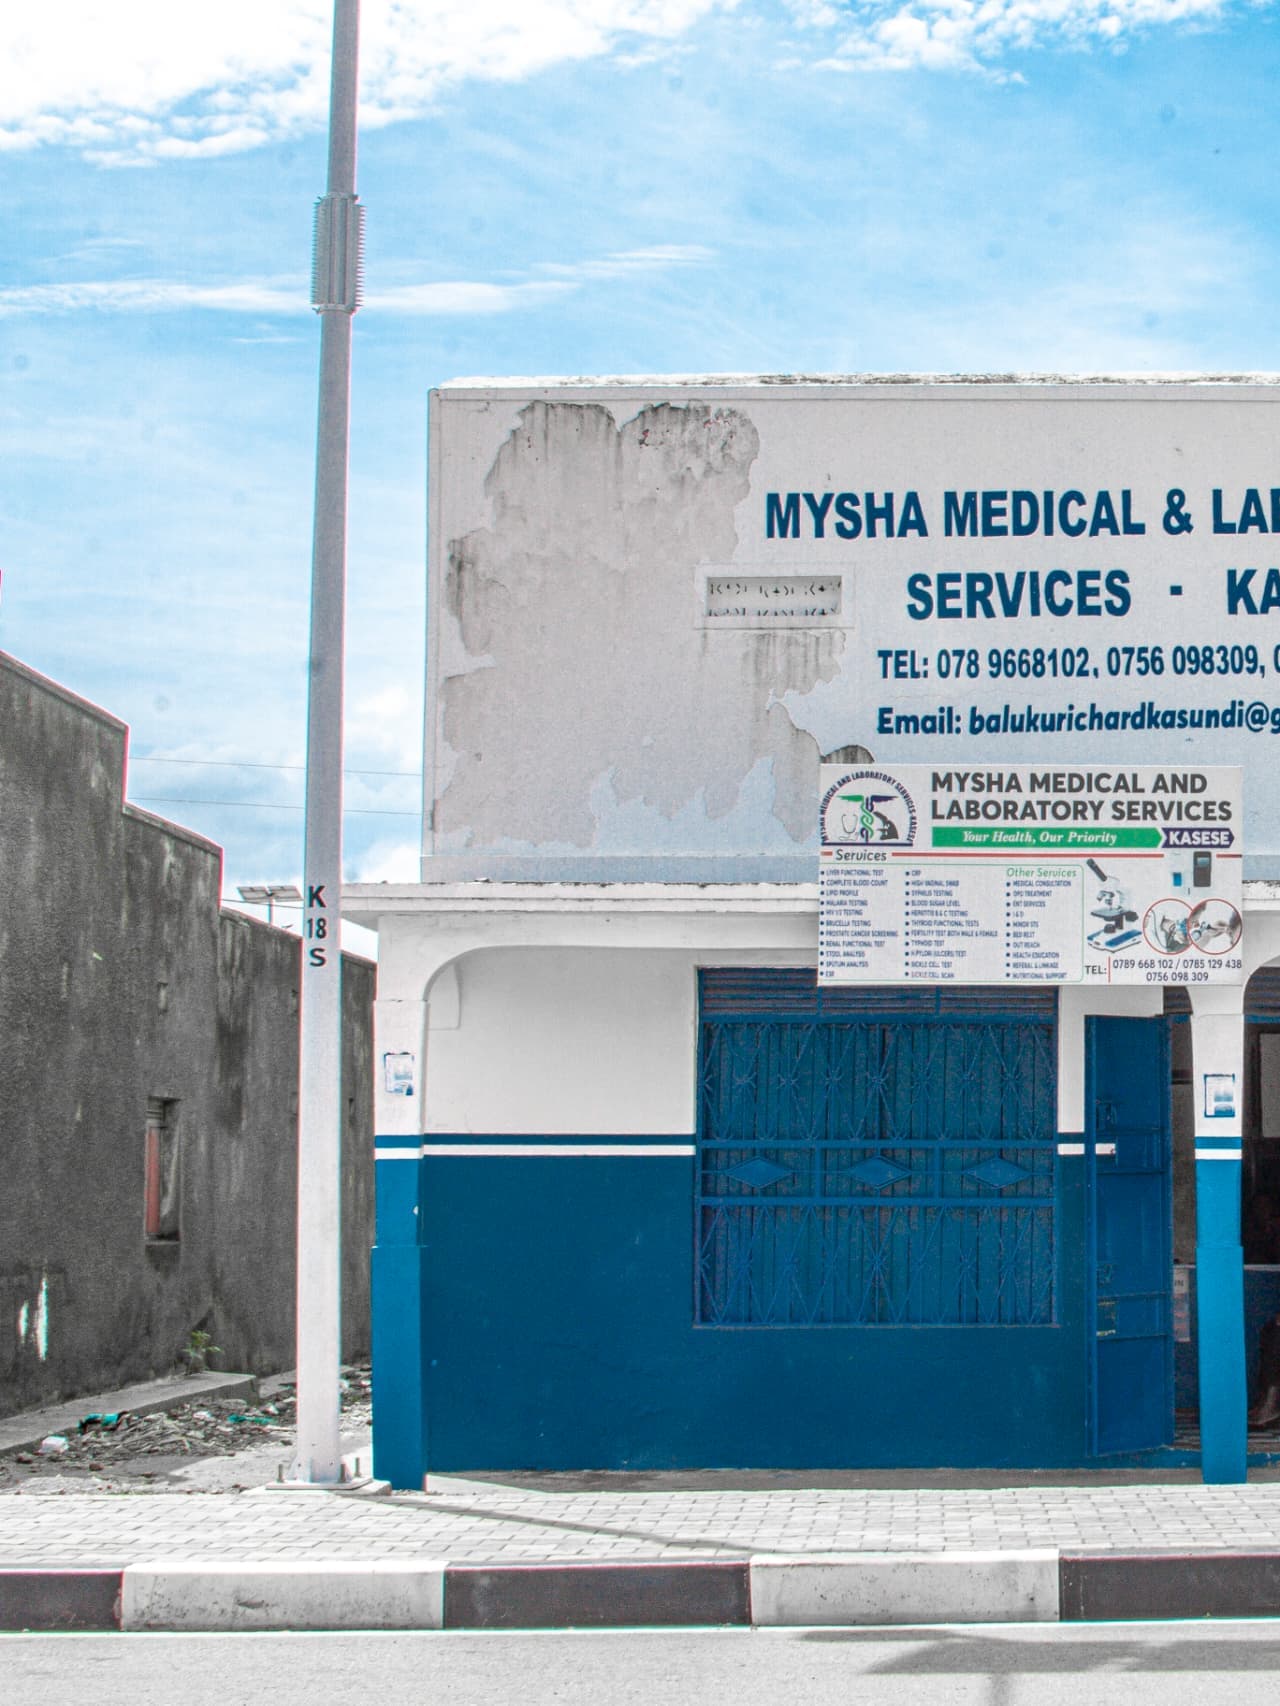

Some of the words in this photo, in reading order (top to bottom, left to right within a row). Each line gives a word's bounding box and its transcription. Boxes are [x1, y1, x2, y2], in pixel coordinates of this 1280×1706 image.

[766, 491, 927, 537] MYSHA
[944, 490, 1146, 536] MEDICAL
[1163, 489, 1193, 534] &
[907, 569, 1131, 620] SERVICES
[1169, 585, 1182, 595] -
[877, 649, 928, 679] TEL:
[937, 649, 979, 678] 078
[987, 648, 1098, 678] 9668102,
[1106, 646, 1164, 676] 0756
[1173, 645, 1264, 676] 098309,
[877, 707, 961, 735] Email:
[932, 772, 1023, 793] MYSHA
[1030, 773, 1145, 793] MEDICAL
[1153, 774, 1207, 794] AND
[932, 799, 1104, 821] LABORATORY
[1111, 801, 1233, 822] SERVICES
[962, 830, 990, 844] Your
[991, 830, 1037, 845] Health,
[1040, 831, 1066, 844] Our
[1068, 831, 1117, 846] Priority
[1168, 830, 1231, 846] KASESE
[835, 848, 887, 862] Services
[1007, 868, 1034, 877] Other
[1037, 868, 1077, 877] Services
[308, 885, 326, 908] K
[307, 917, 327, 939] 18
[309, 947, 326, 967] S
[1112, 959, 1136, 969] 0789
[1138, 959, 1156, 969] 668
[1158, 959, 1174, 969] 102
[1182, 959, 1205, 970] 0785
[1207, 959, 1223, 970] 129
[1225, 959, 1243, 970] 438
[1085, 965, 1107, 975] TEL:
[1146, 971, 1169, 982] 0756
[1170, 971, 1189, 982] 098
[1192, 971, 1209, 982] 309
